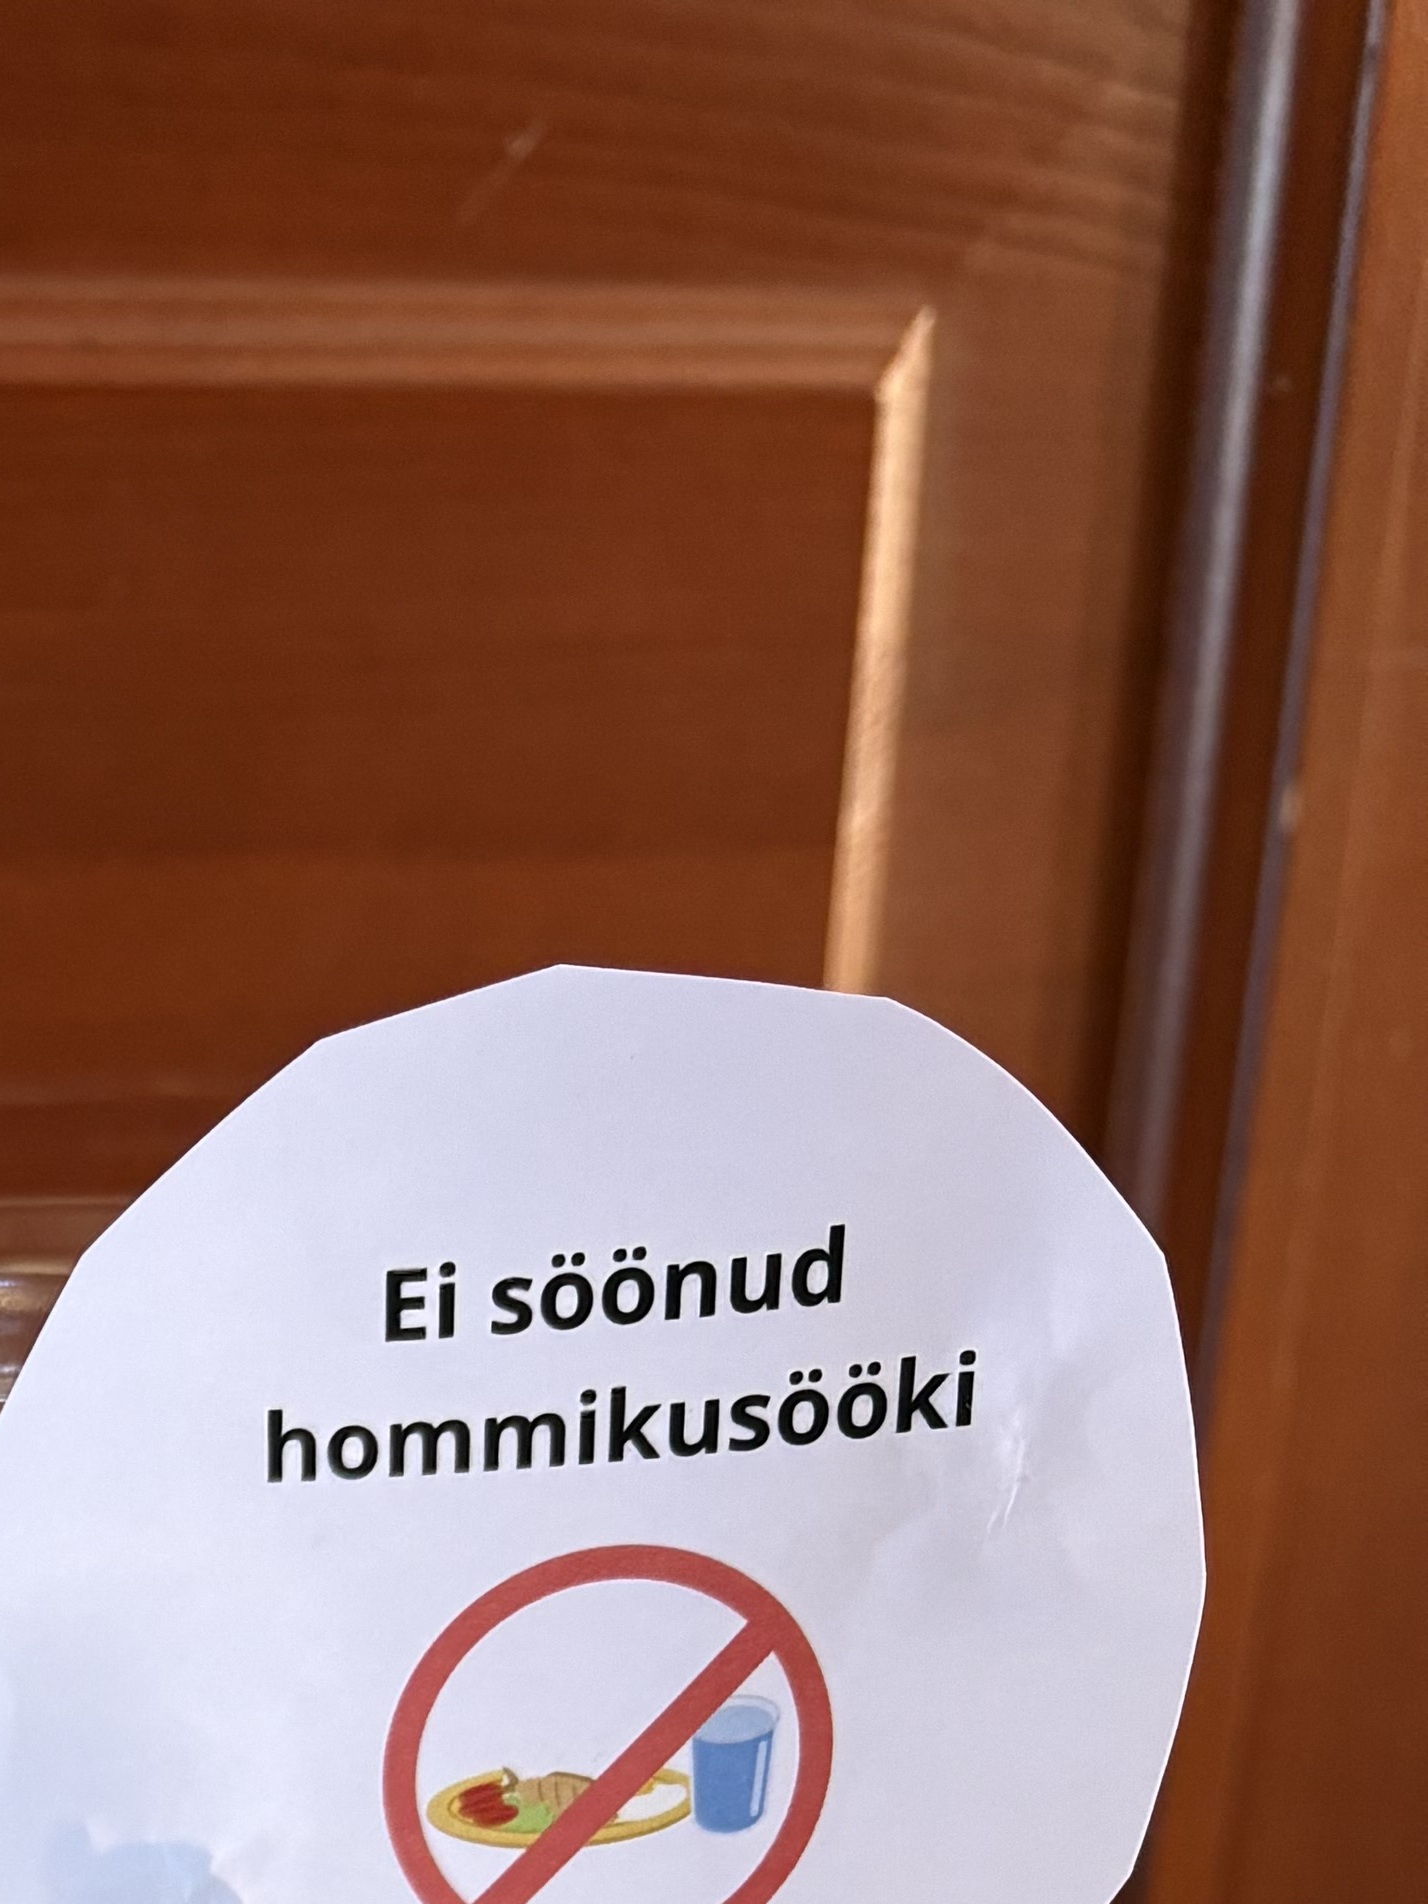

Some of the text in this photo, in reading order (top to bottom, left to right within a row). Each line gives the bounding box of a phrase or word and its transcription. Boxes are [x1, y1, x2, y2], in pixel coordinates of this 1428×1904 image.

[382, 1225, 847, 1342] Ei söönud
[266, 1351, 978, 1484] hommikusööki
